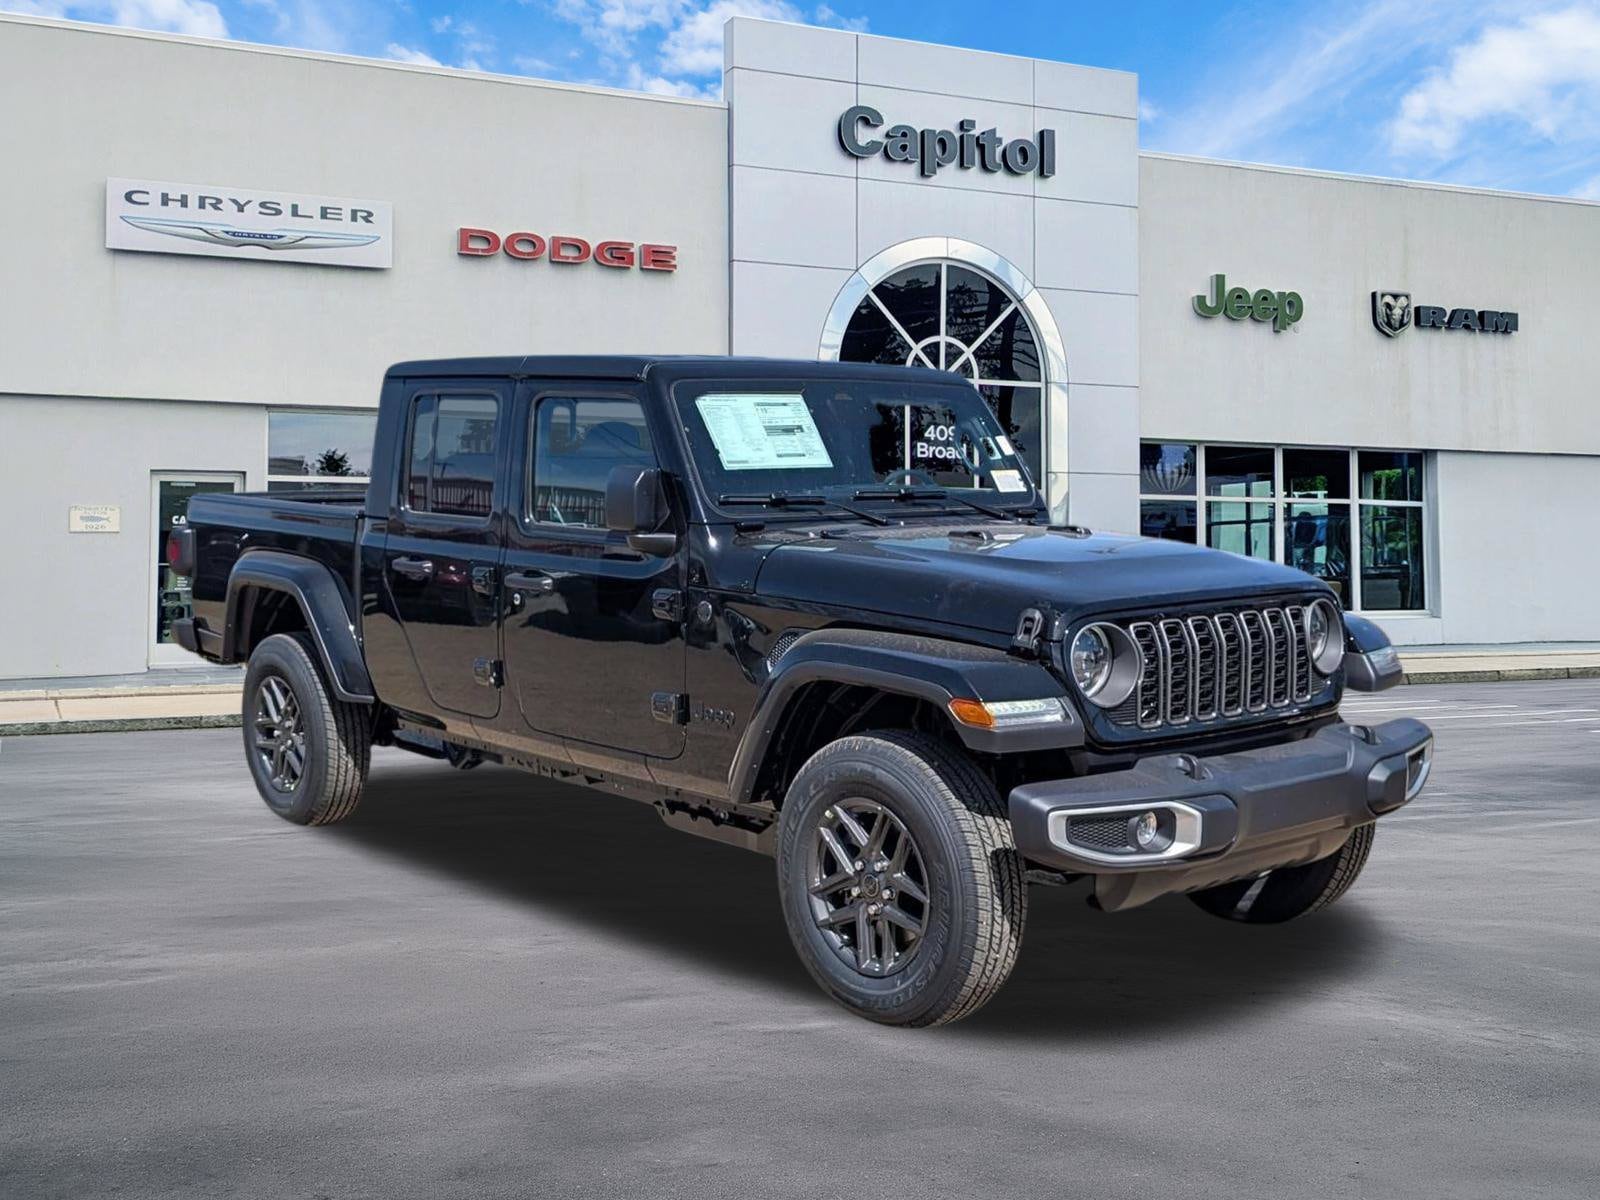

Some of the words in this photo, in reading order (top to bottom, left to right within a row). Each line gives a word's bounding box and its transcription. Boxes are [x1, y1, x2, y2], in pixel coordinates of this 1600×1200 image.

[838, 105, 1056, 178] Capitol
[123, 189, 375, 224] CHRYSLER
[228, 231, 279, 240] CHRYSLER
[457, 227, 678, 271] DODGE
[1192, 273, 1304, 333] Jeep
[1414, 305, 1519, 333] RAM
